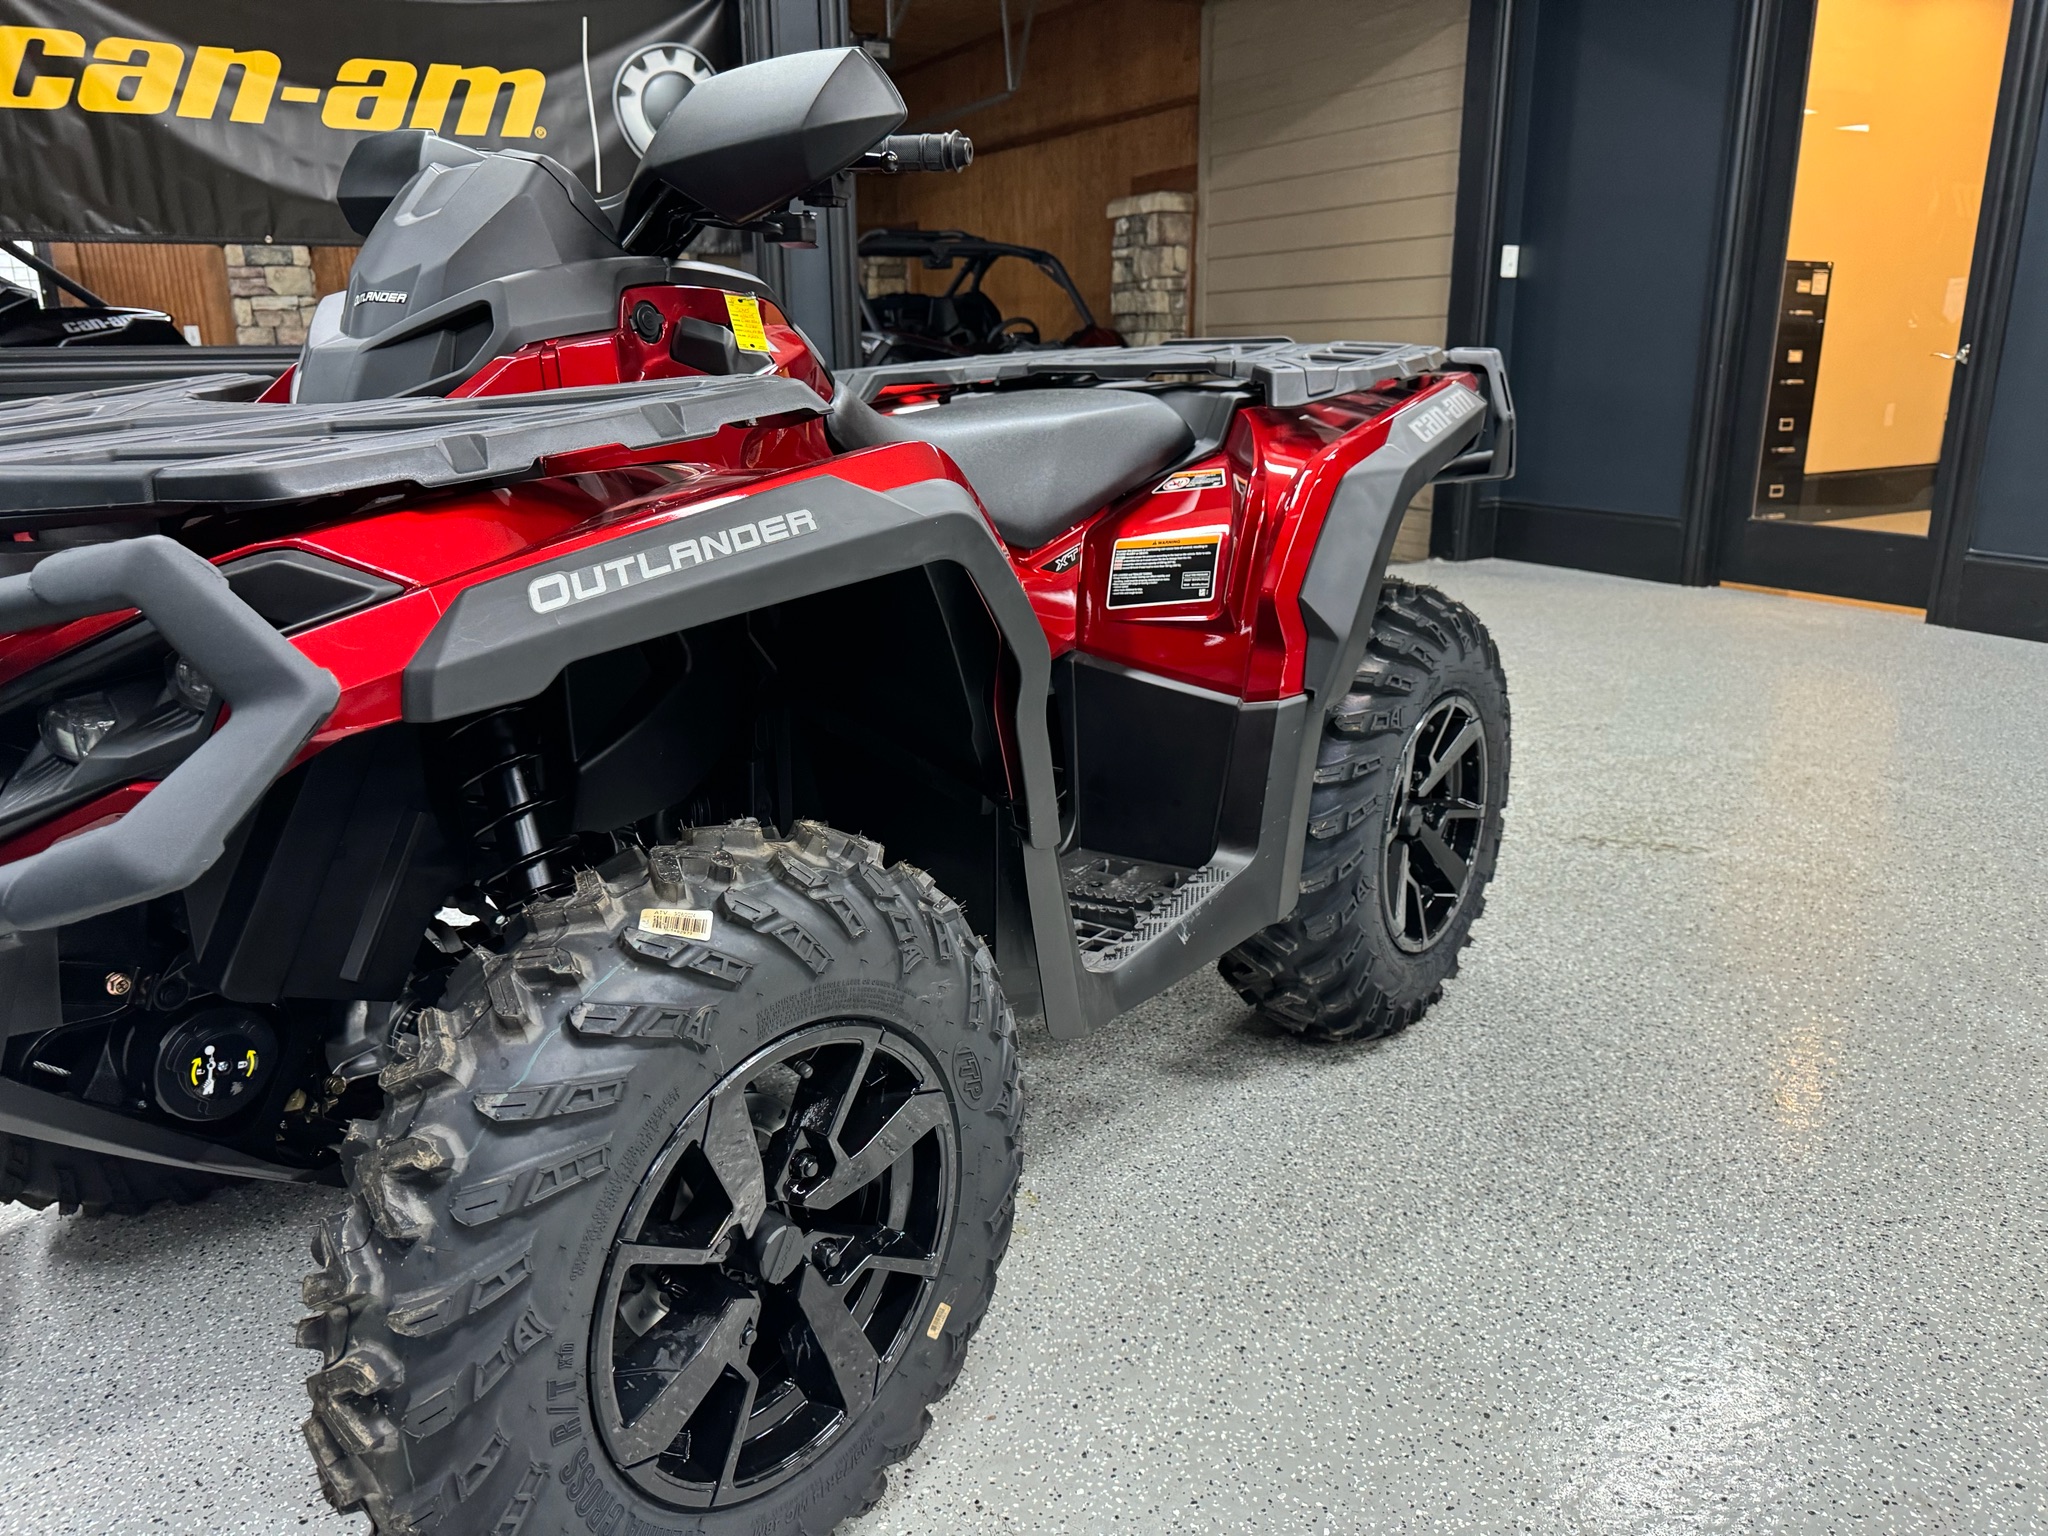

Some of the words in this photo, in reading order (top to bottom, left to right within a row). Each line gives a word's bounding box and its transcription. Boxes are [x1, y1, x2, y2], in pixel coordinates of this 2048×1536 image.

[0, 25, 547, 137] can-am
[1408, 389, 1475, 442] can-am
[529, 510, 819, 614] OUTLANDER
[1055, 547, 1078, 572] XT
[959, 1049, 983, 1102] ITP
